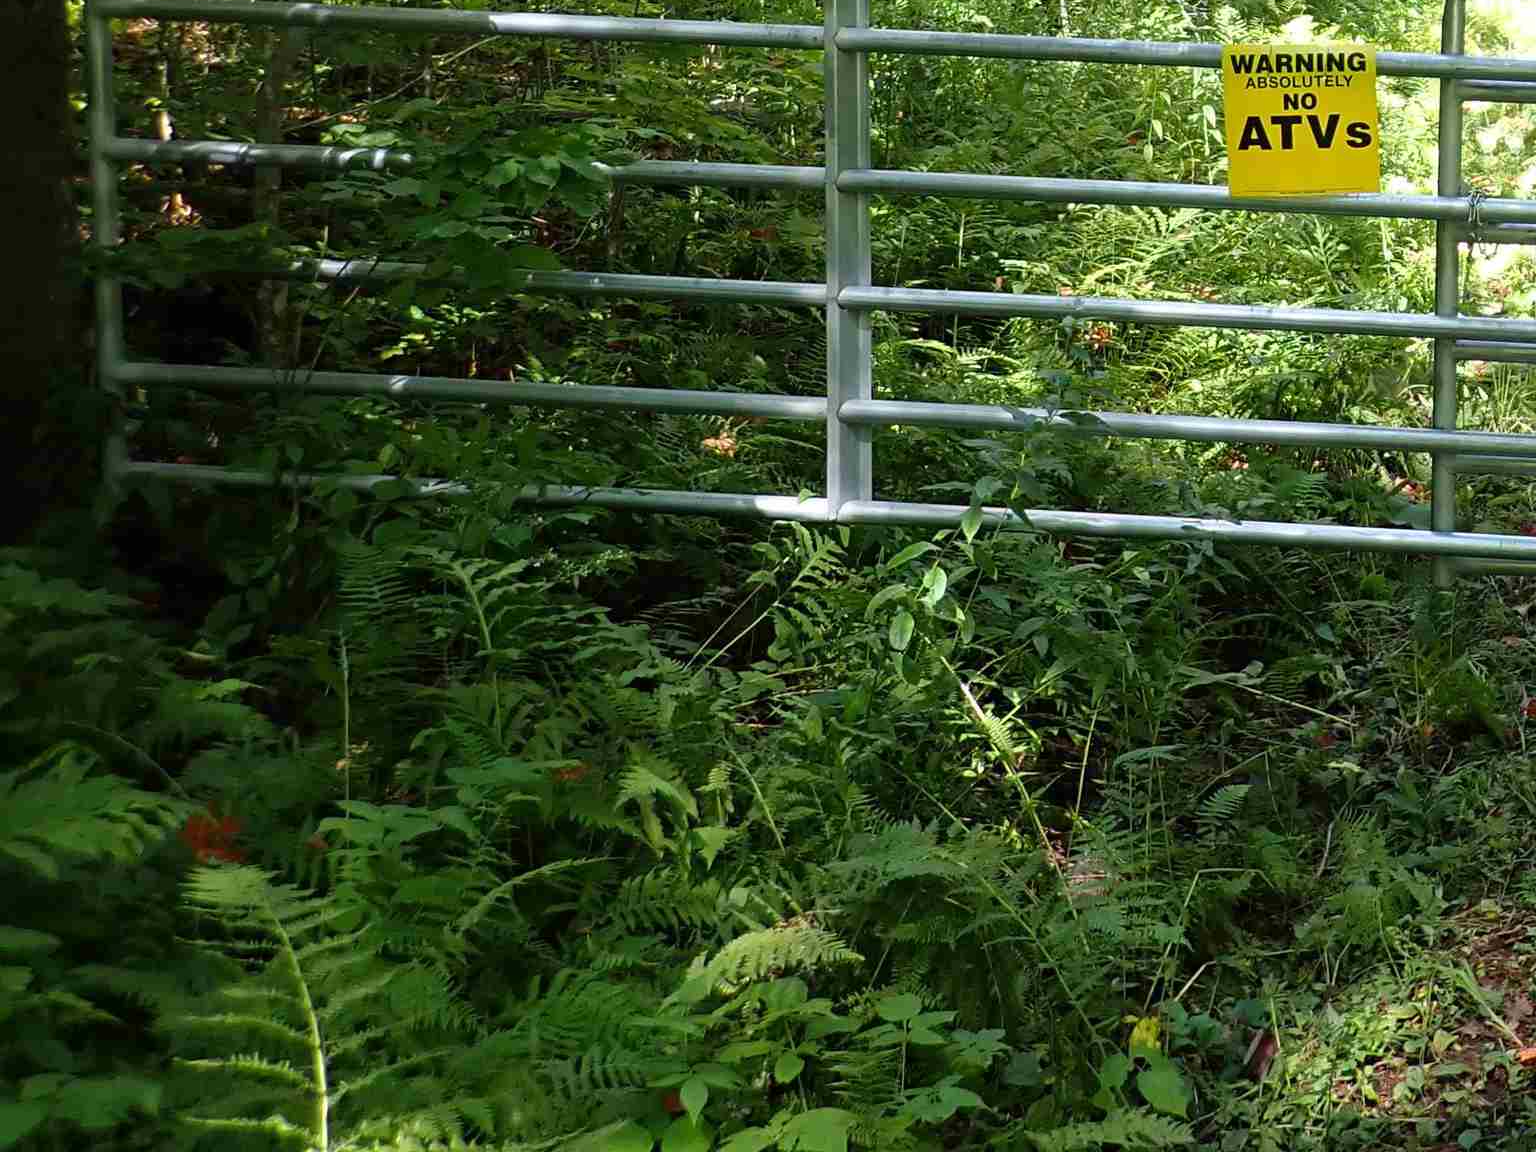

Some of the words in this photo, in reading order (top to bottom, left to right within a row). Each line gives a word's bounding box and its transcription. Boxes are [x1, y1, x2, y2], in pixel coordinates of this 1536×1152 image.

[1229, 52, 1366, 74] WARNING
[1246, 75, 1353, 89] ABSOLUTELY
[1283, 93, 1317, 110] NO
[1238, 114, 1372, 150] ATVs
